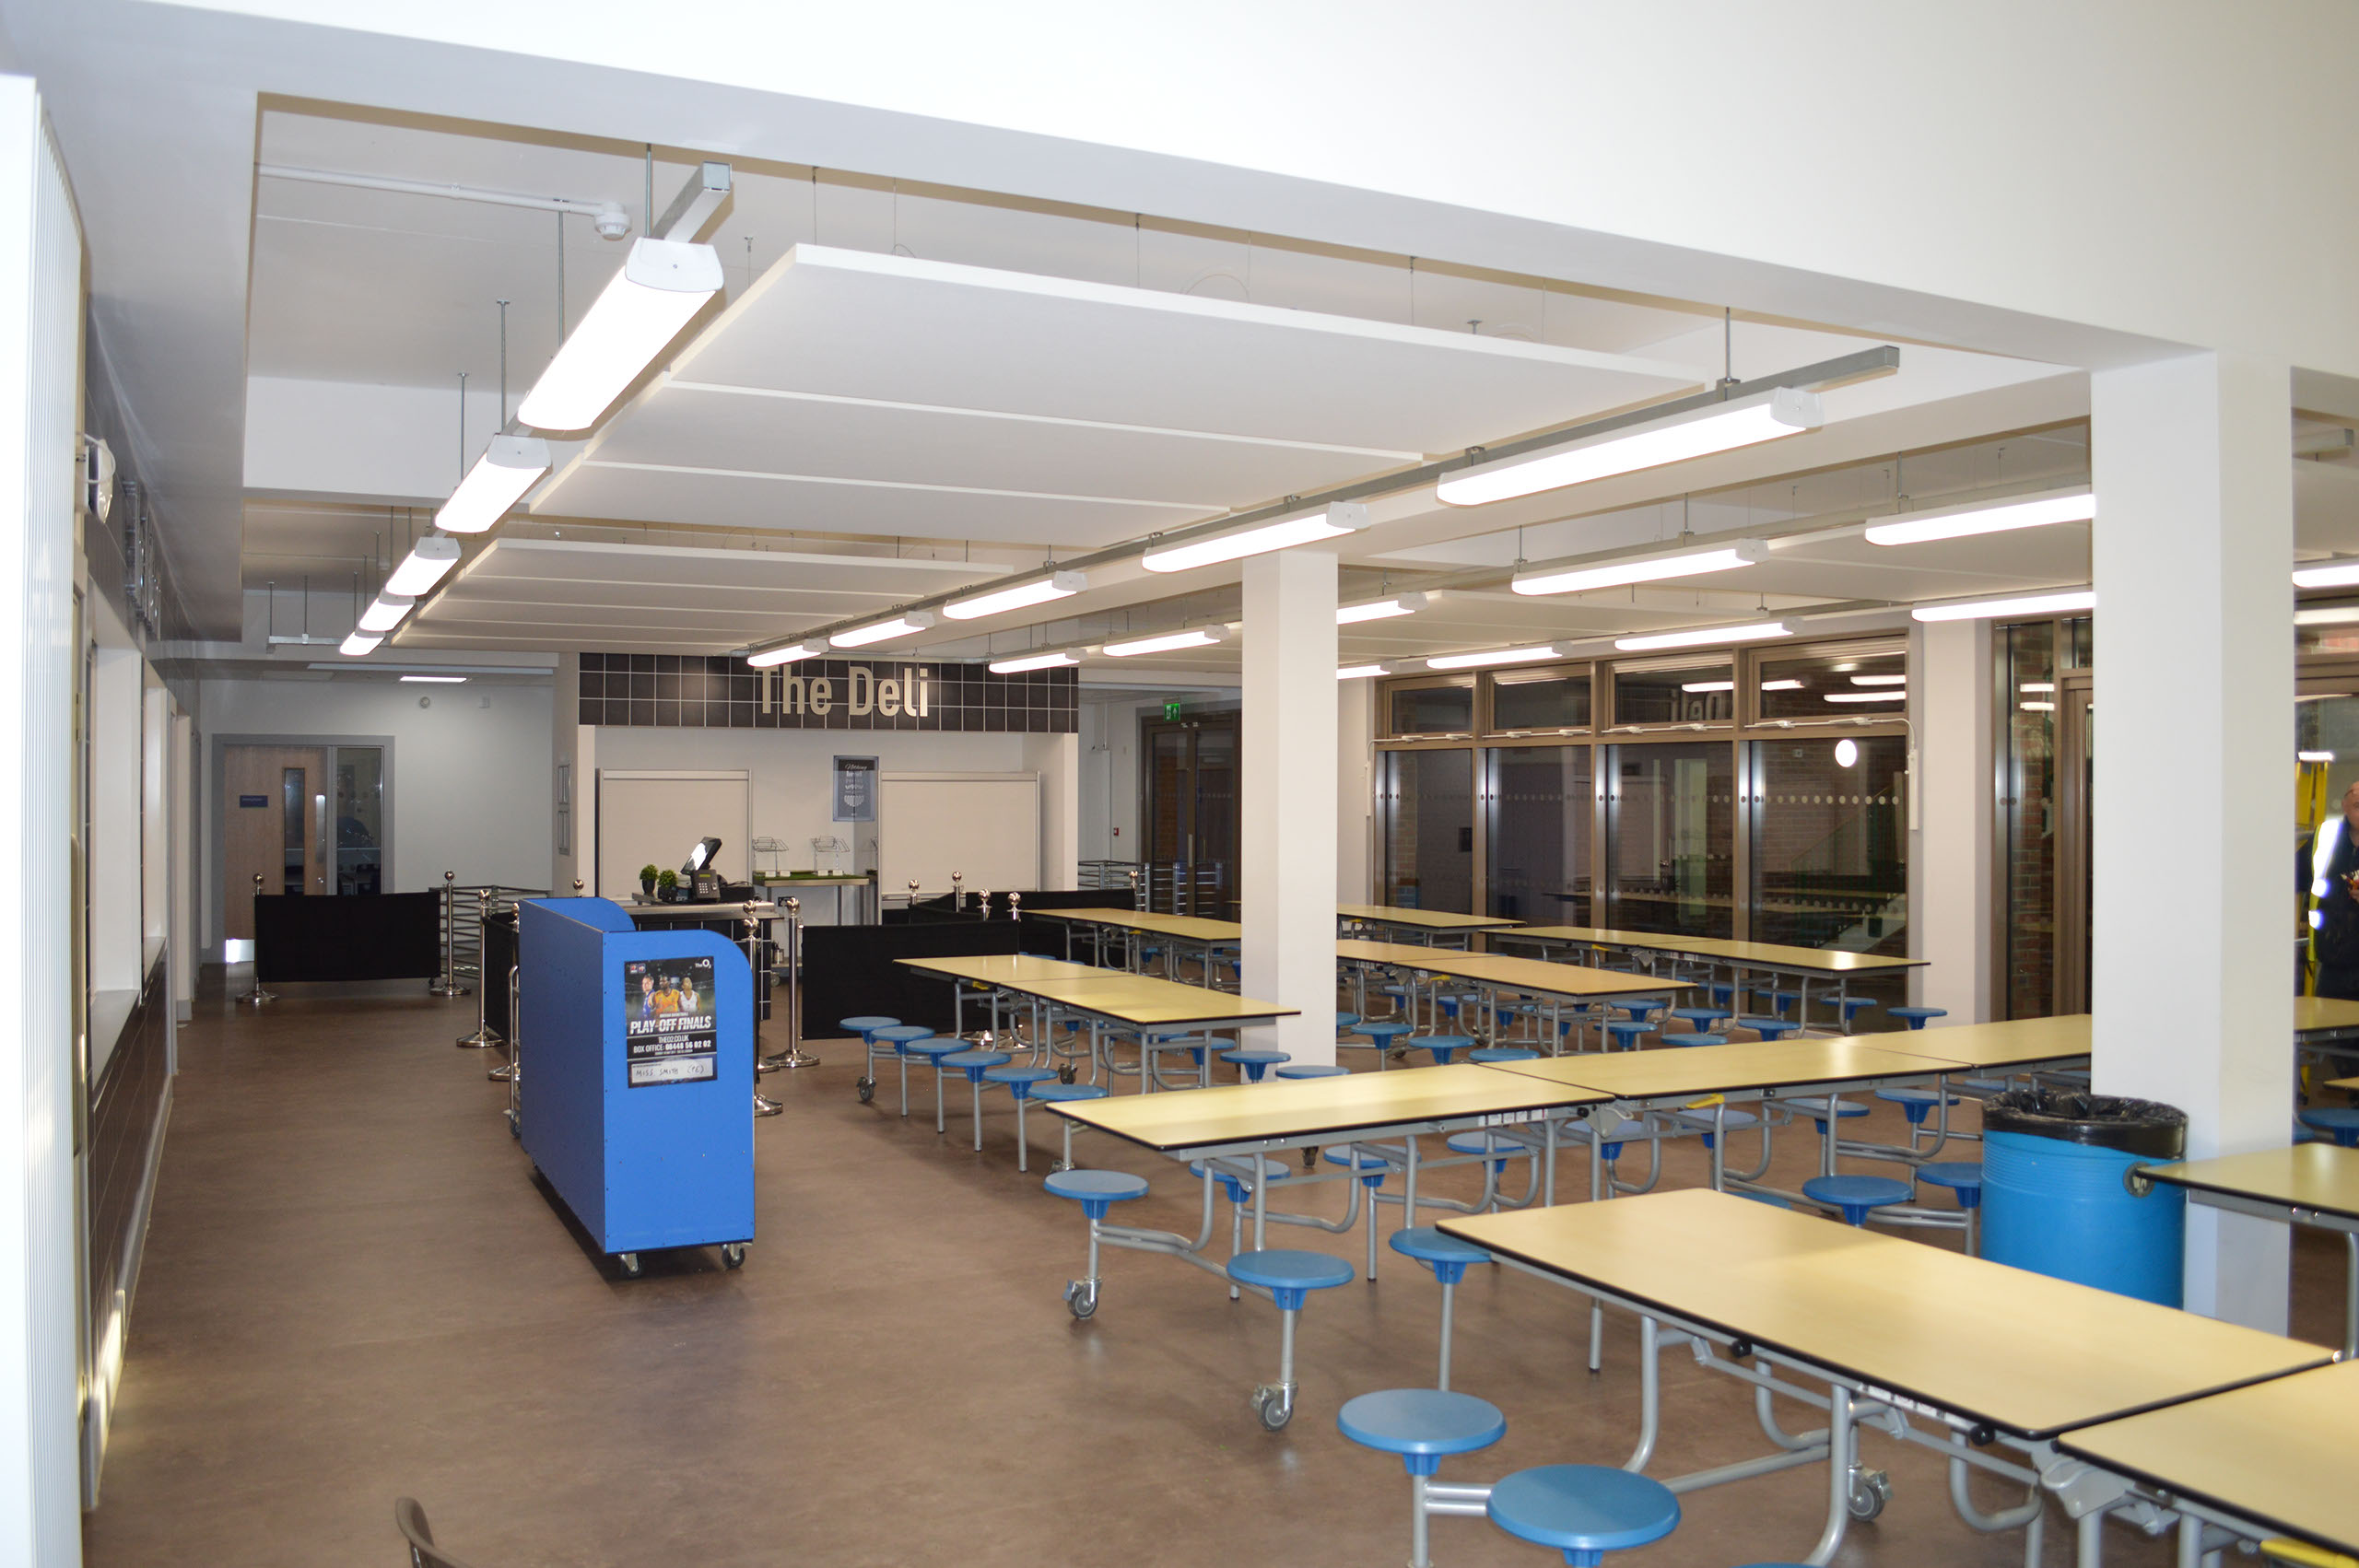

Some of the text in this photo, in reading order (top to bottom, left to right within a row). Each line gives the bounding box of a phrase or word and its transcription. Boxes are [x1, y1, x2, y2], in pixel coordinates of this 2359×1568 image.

[754, 664, 928, 717] The Deli
[629, 1015, 711, 1034] PLAY-OFF FINALS
[633, 1045, 645, 1054] BOX
[694, 1040, 702, 1048] 02
[702, 1039, 711, 1047] 02
[636, 1068, 654, 1077] MISS
